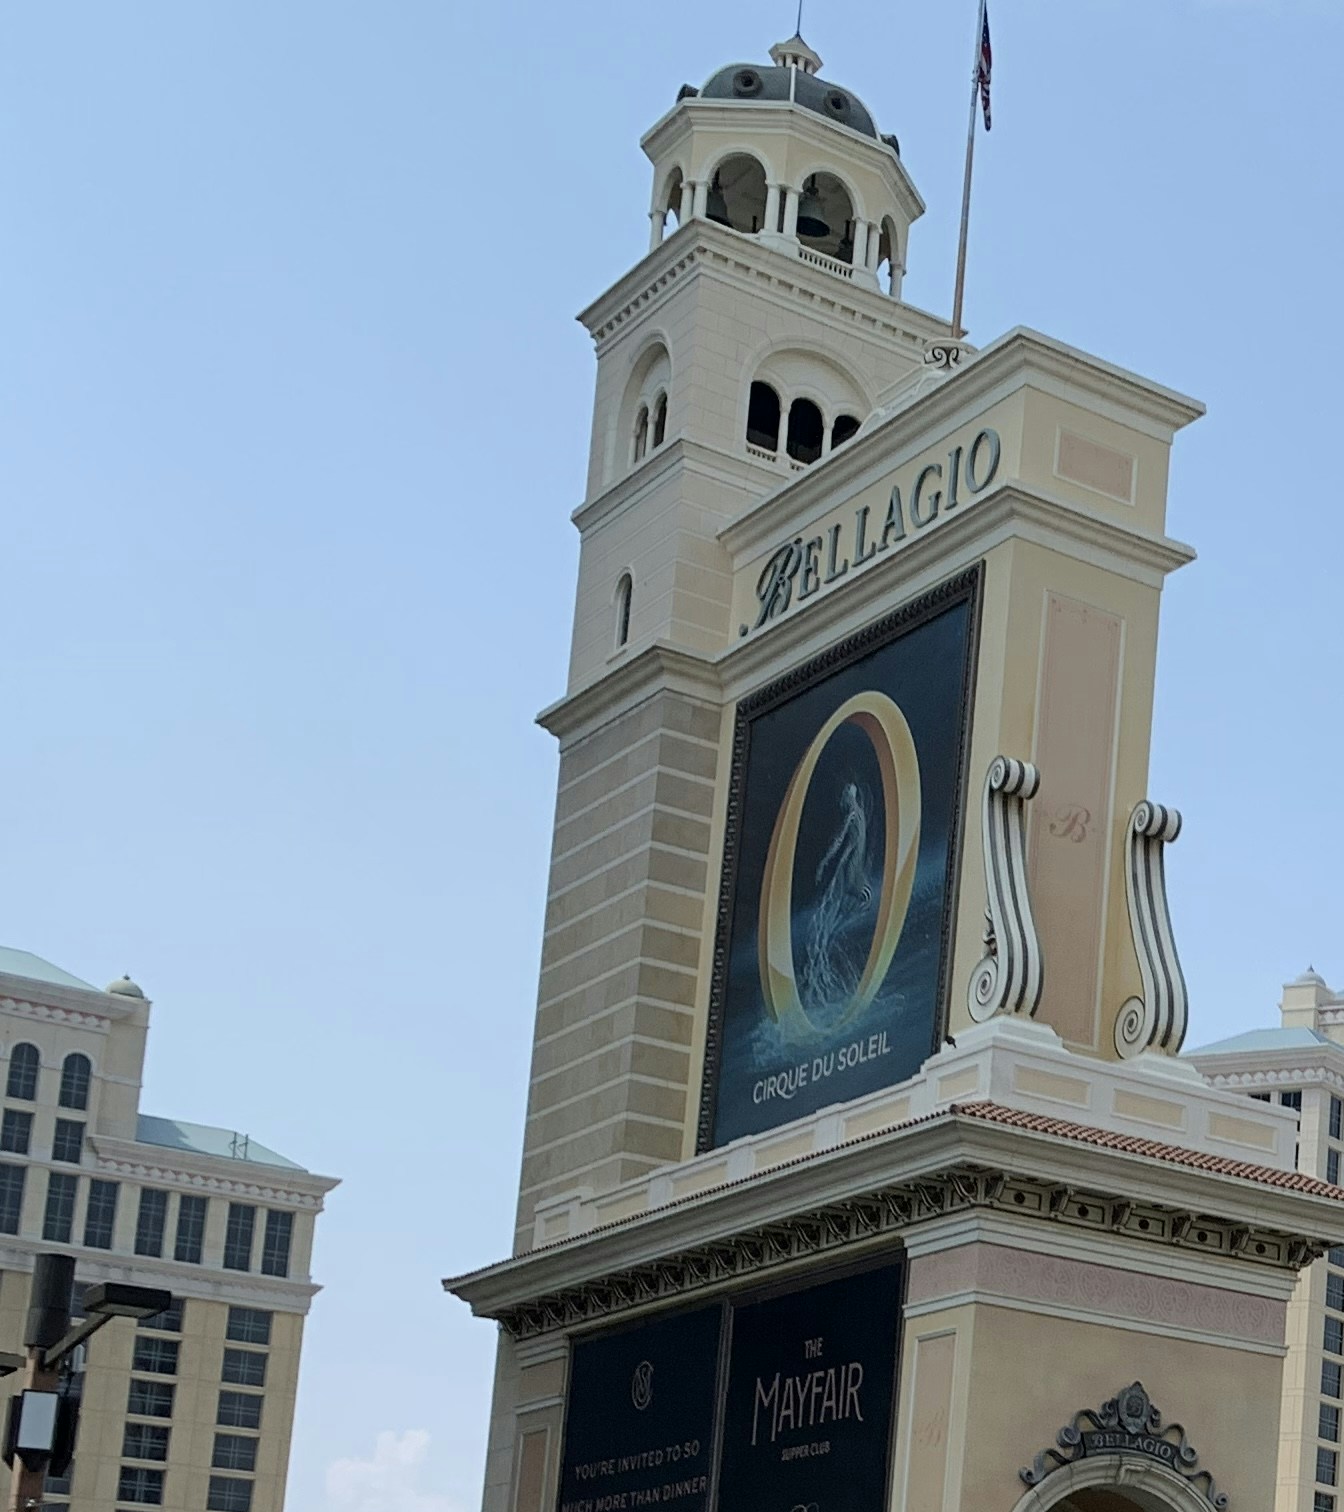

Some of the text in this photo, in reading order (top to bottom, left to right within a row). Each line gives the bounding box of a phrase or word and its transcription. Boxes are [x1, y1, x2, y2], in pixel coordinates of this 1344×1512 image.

[739, 427, 1001, 637] BELLAGIO
[753, 1031, 891, 1104] CIRQUE DU SOLEIL
[804, 1337, 824, 1359] THE
[751, 1361, 864, 1446] MAYFAIR
[575, 1439, 700, 1481] YOU'RE INVITED TO SO
[1091, 1433, 1172, 1459] BELLAGIO
[631, 1486, 660, 1507] THAN
[662, 1475, 708, 1502] DINNER
